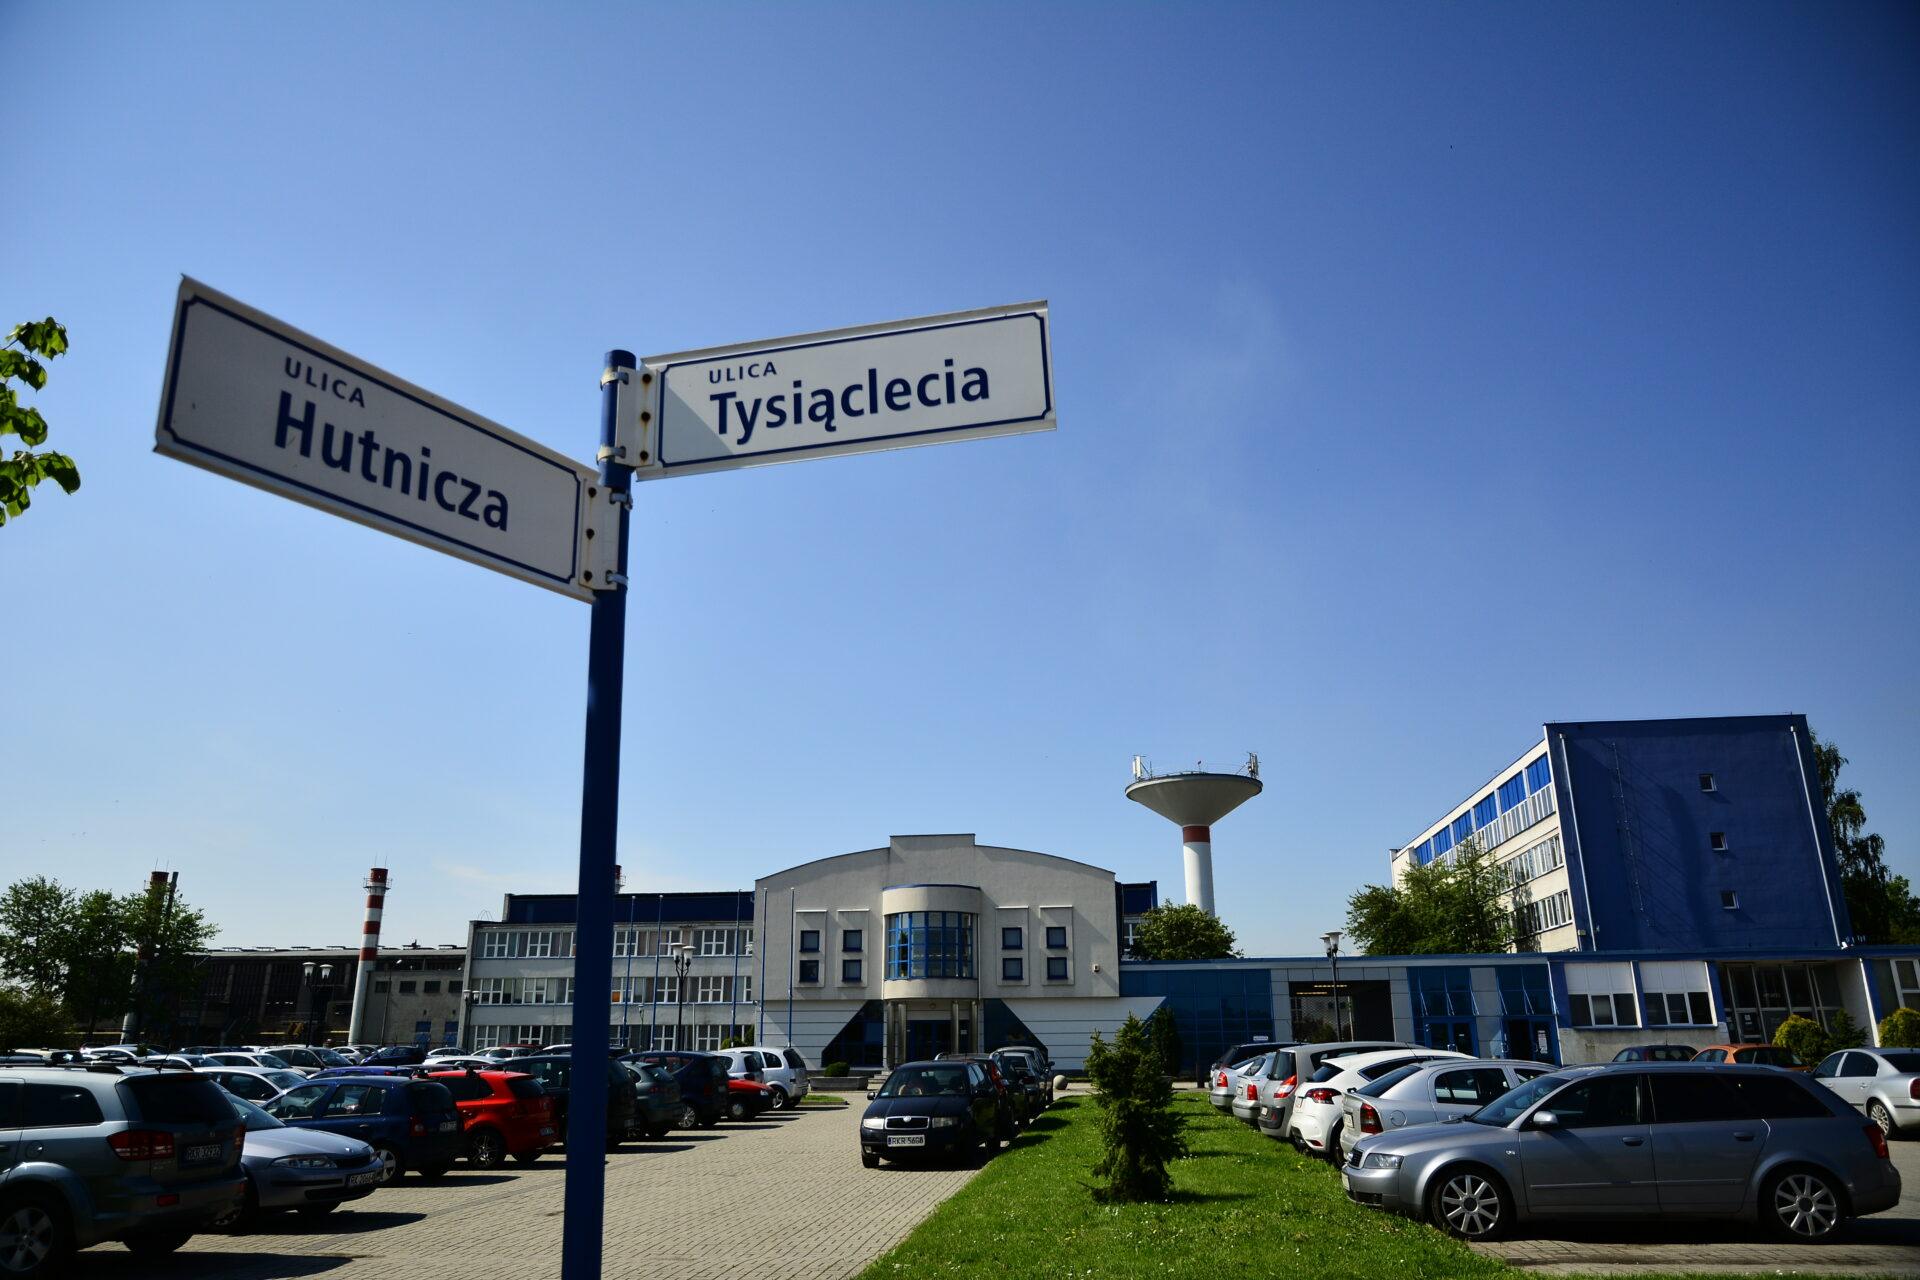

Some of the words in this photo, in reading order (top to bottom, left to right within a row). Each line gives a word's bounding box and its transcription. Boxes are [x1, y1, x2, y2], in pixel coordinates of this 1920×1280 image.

[283, 354, 366, 409] ULICA
[709, 361, 777, 384] ULICA
[709, 358, 990, 446] Tysiąclecia
[274, 389, 509, 532] Hutnicza
